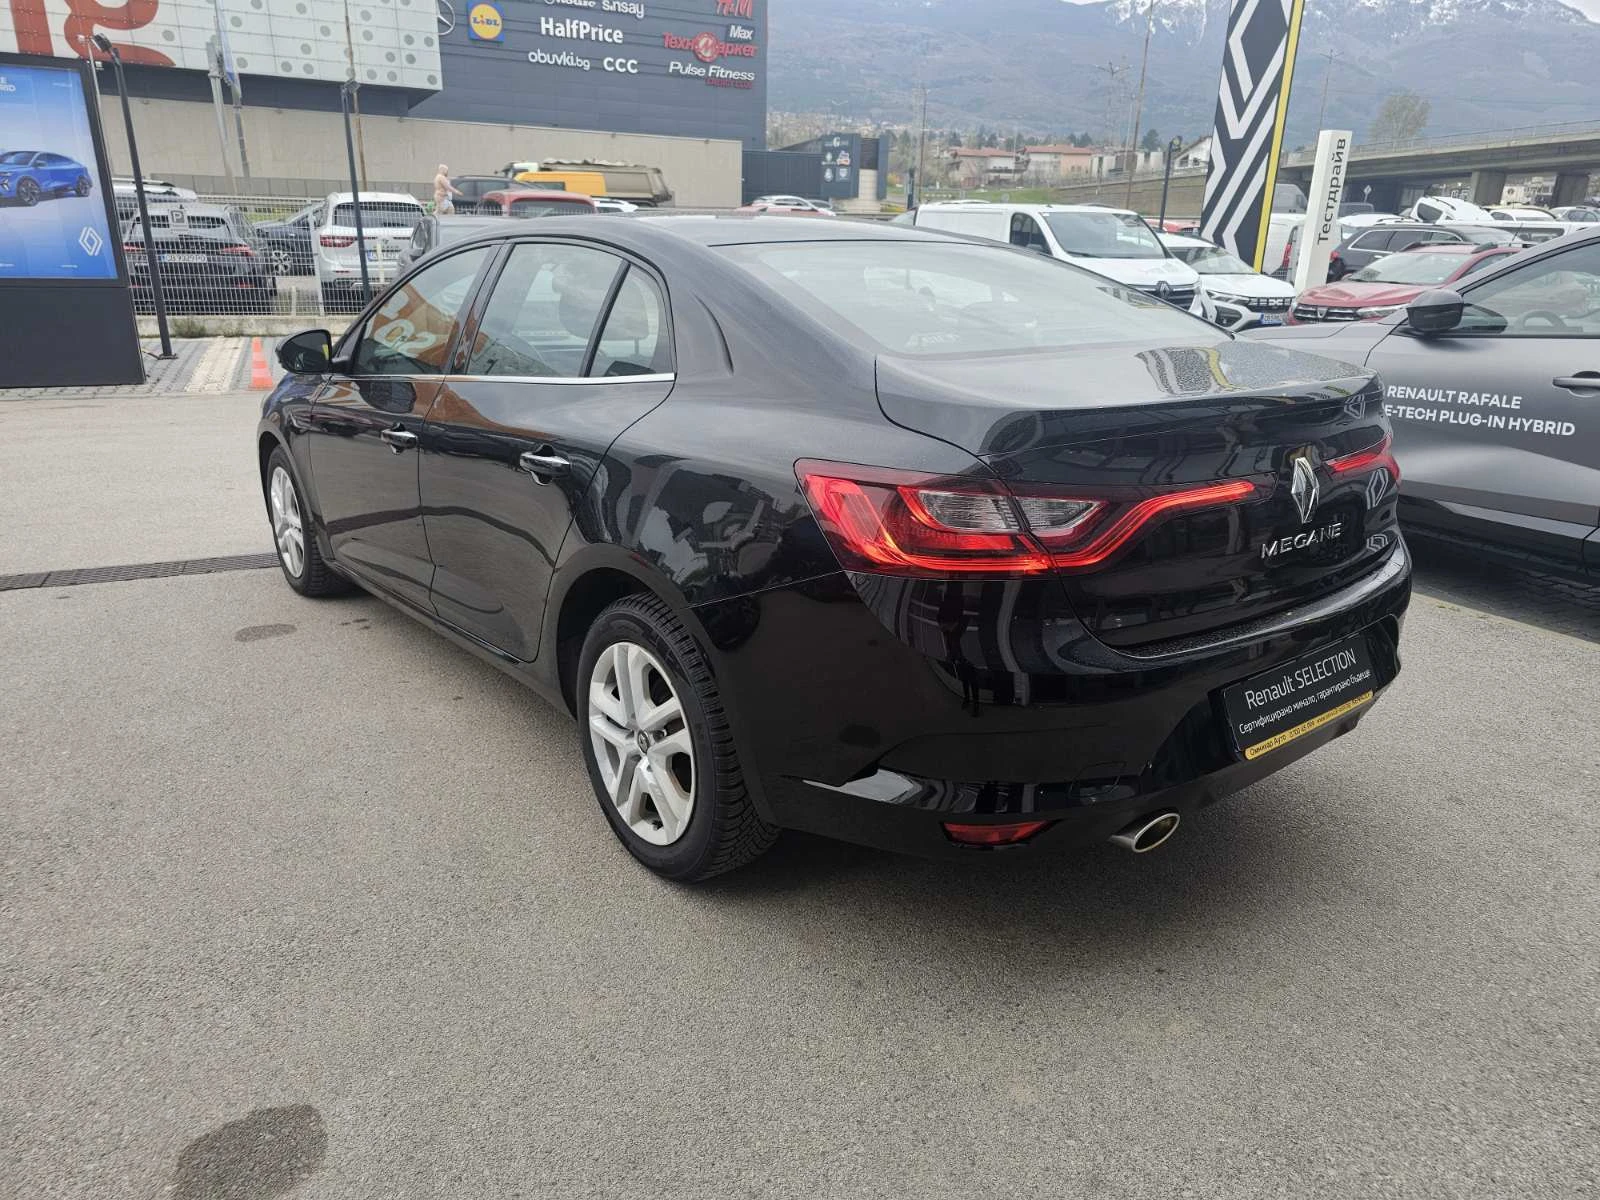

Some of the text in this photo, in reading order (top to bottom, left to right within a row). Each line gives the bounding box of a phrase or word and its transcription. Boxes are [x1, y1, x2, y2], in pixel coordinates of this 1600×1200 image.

[540, 17, 624, 43] HalfPrice
[729, 25, 754, 40] Max
[528, 49, 591, 70] obuvki.bg
[668, 61, 755, 81] Pulse Fitness
[1318, 138, 1346, 245] Тестдрайв
[1387, 385, 1522, 409] RENAULT RAFALE
[1385, 404, 1576, 436] E-TECH PLUG-IN HYBRID
[1260, 522, 1342, 558] MEGANE
[1244, 676, 1296, 709] Renault
[1294, 648, 1357, 689] SELECTION
[1239, 705, 1293, 734] Сертифицирано
[1316, 678, 1351, 701] гарантирано
